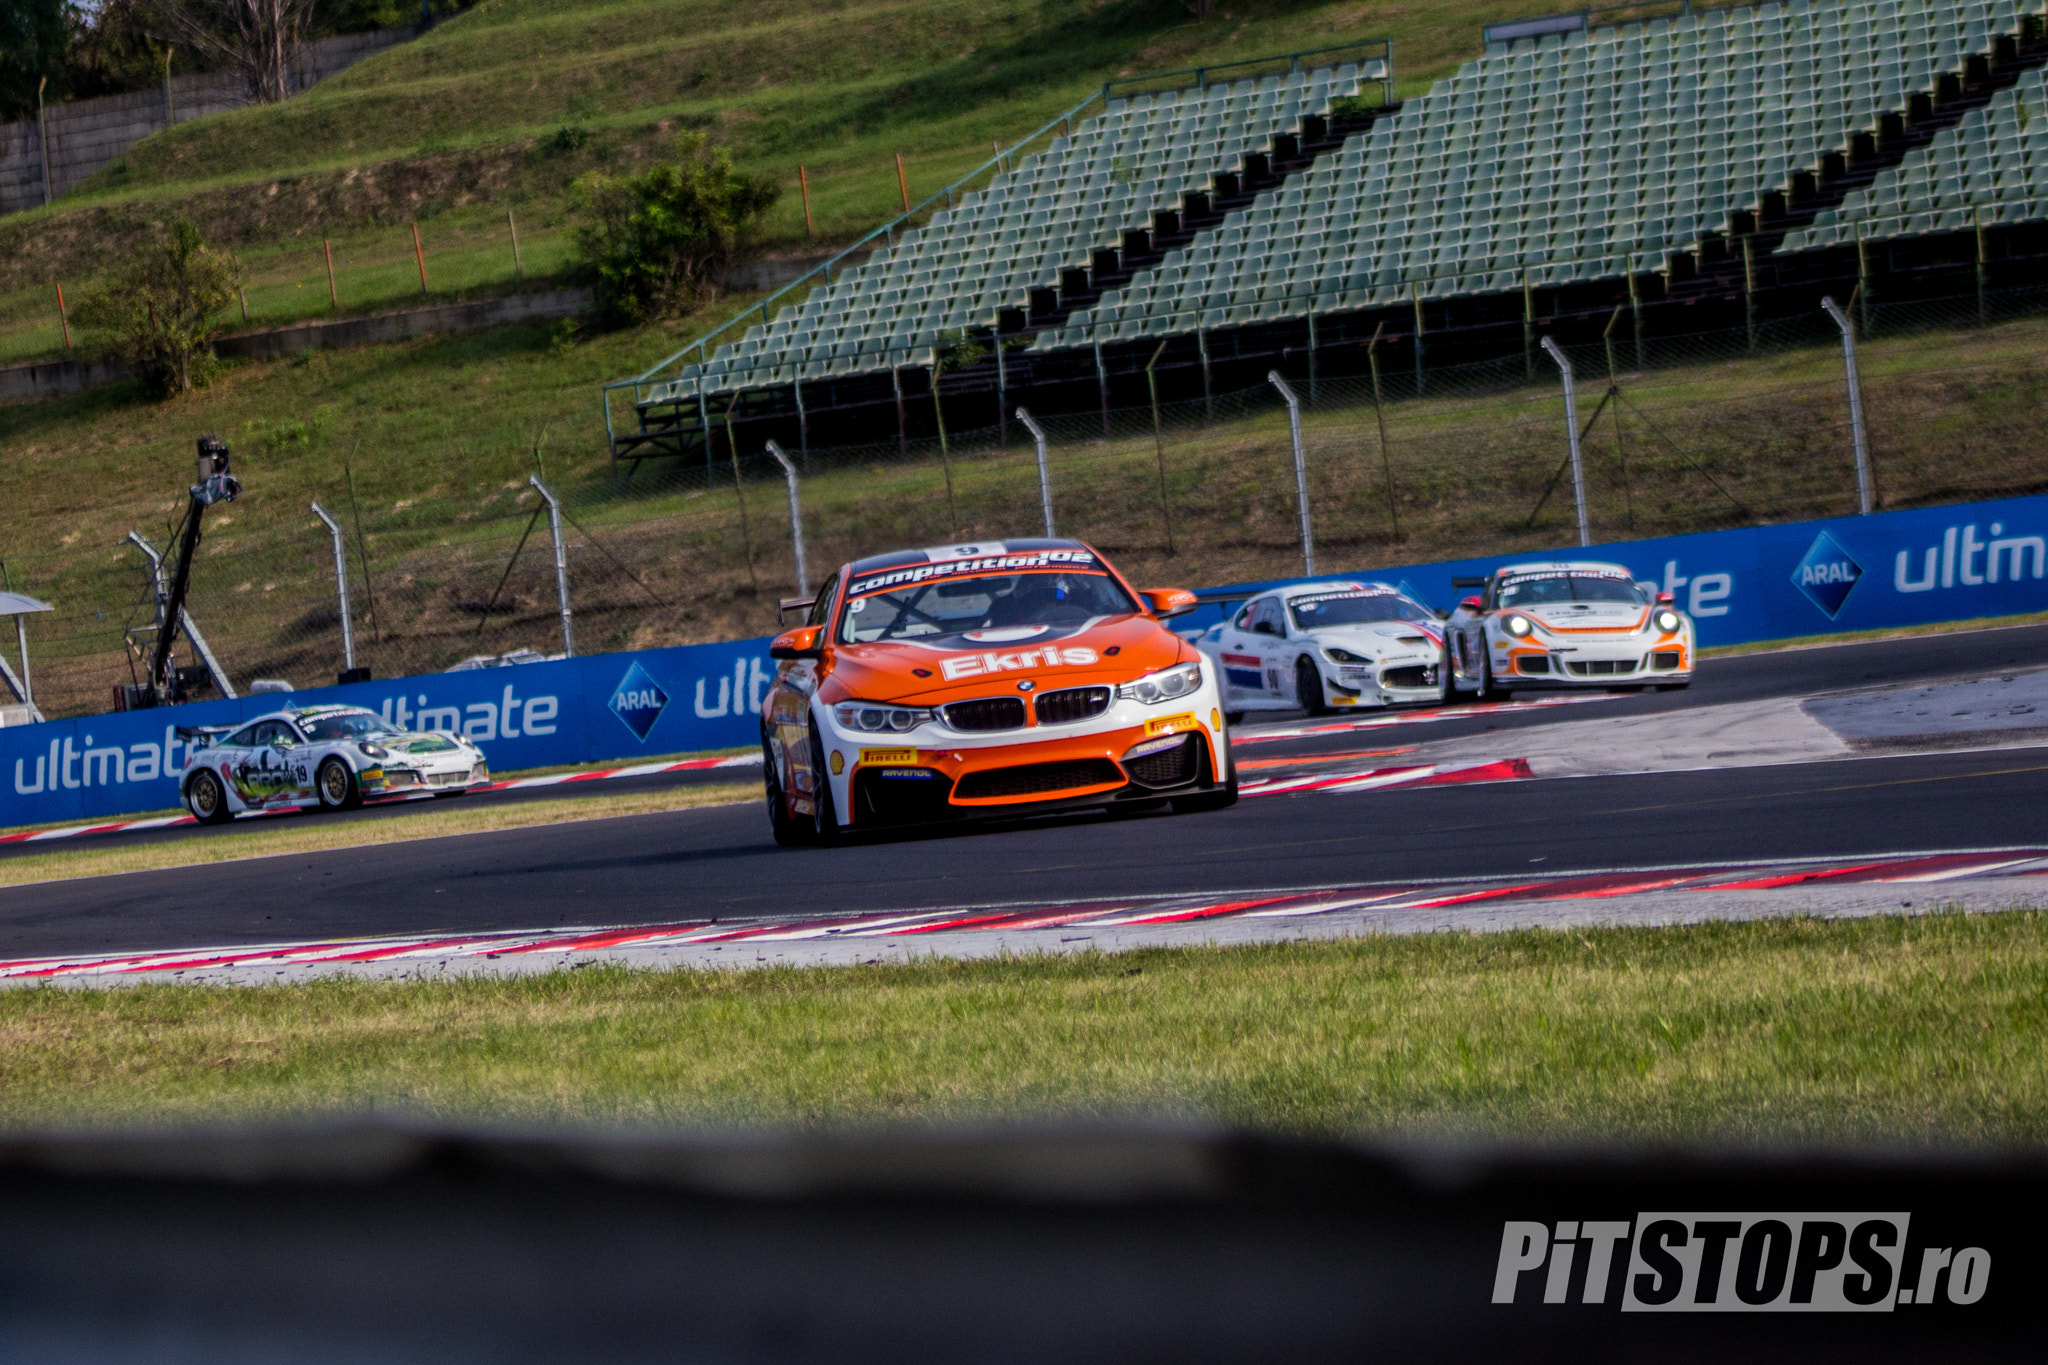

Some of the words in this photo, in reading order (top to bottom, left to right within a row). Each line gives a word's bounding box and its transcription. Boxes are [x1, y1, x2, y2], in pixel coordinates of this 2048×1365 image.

[1802, 561, 1855, 587] ARAL
[851, 598, 866, 614] 9
[939, 646, 1099, 682] Ekris
[616, 691, 662, 712] ARAL
[1136, 736, 1182, 754] RAVENOL
[863, 749, 911, 763] PIRELLI
[296, 765, 308, 784] 19
[882, 769, 932, 777] RAVENOL
